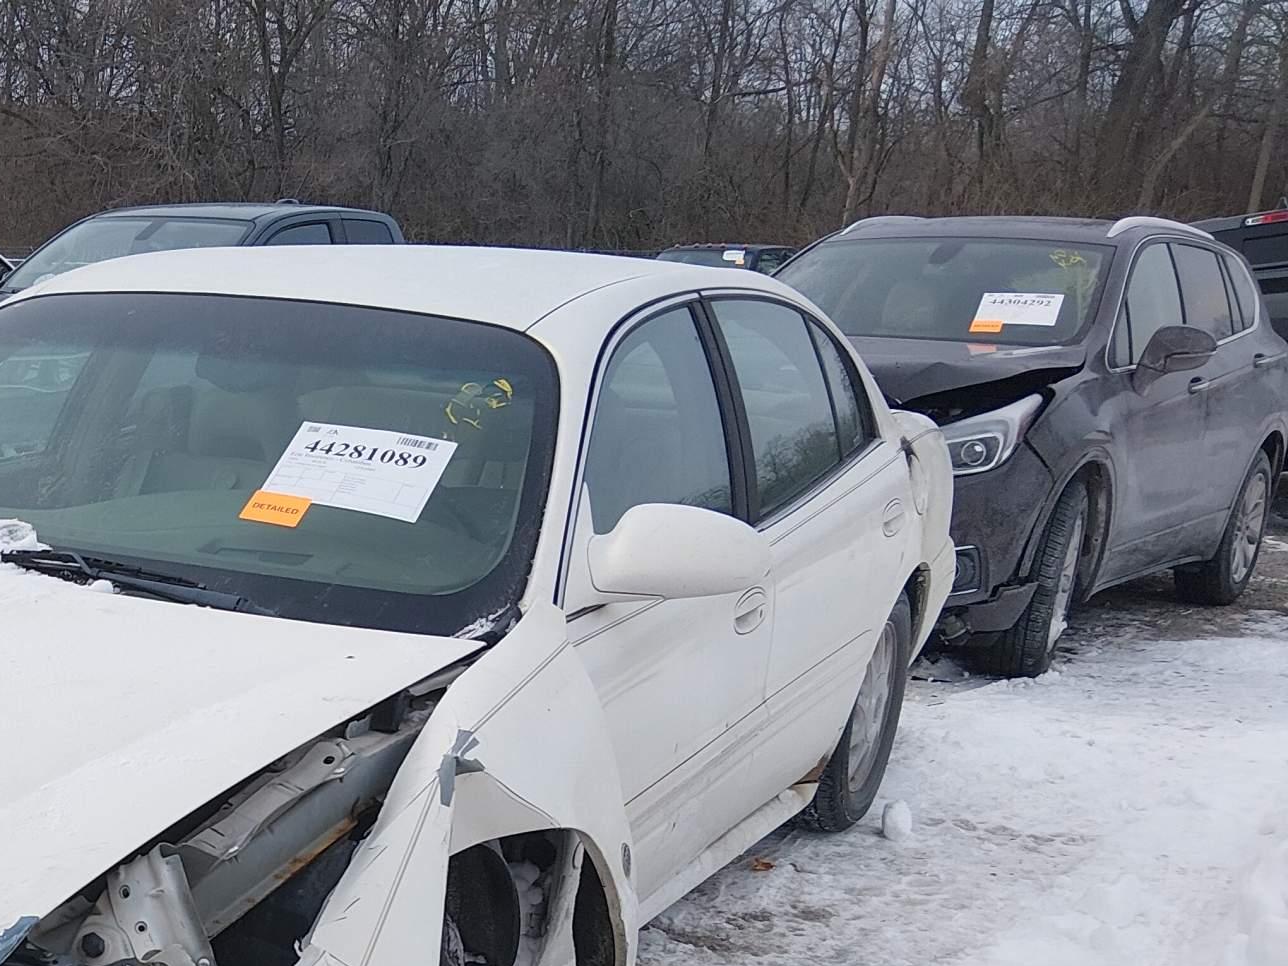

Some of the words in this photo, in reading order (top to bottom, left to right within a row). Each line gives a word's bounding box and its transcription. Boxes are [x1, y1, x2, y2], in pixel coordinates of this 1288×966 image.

[988, 298, 1051, 307] 44304292
[304, 439, 427, 469] 44281089
[252, 502, 299, 515] DETAILED
